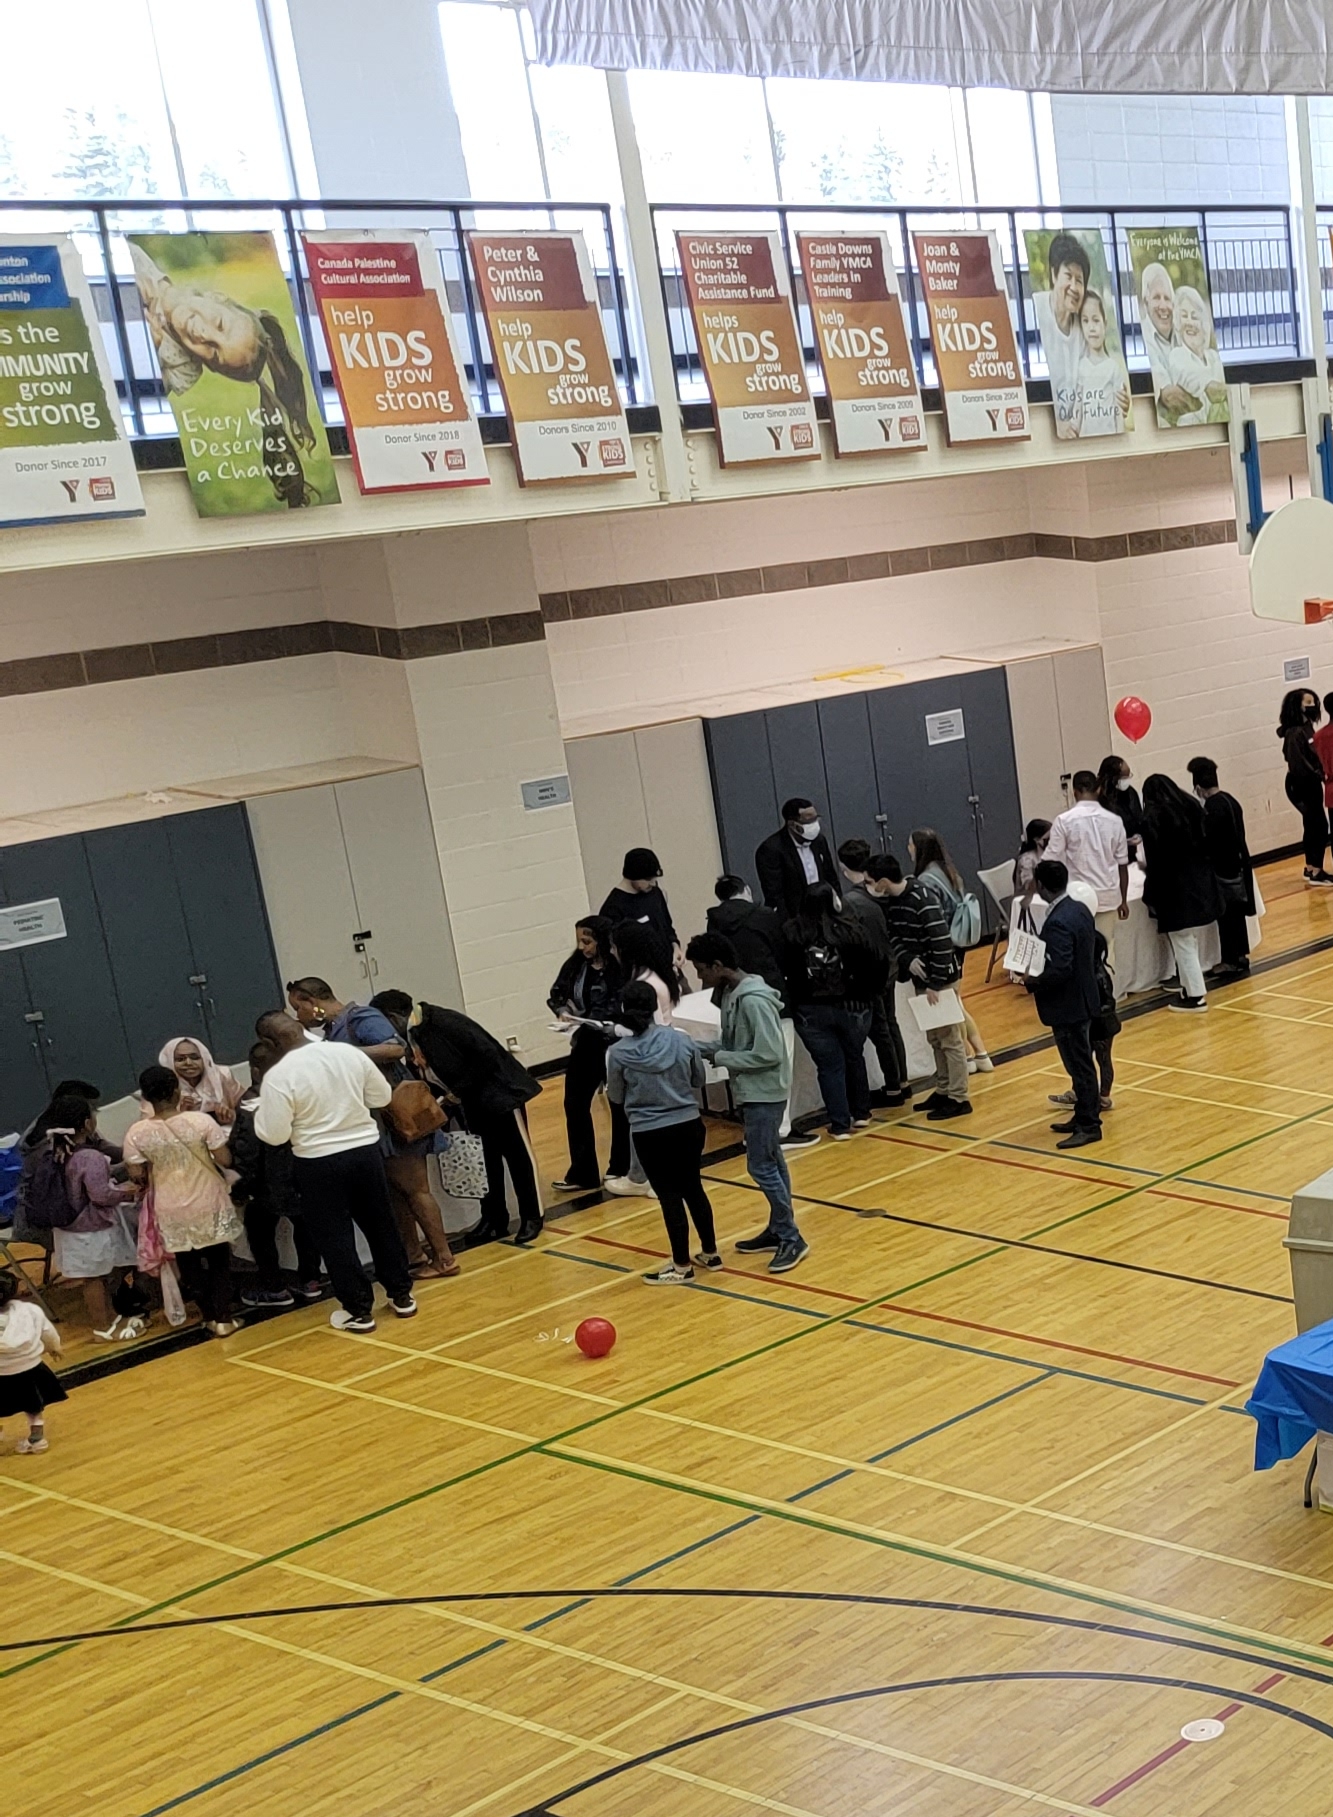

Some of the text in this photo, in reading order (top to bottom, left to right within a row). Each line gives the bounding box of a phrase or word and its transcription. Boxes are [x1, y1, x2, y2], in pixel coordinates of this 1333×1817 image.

[483, 246, 539, 262] Peter &
[689, 241, 752, 255] Civic Service
[809, 243, 871, 255] Castle Downs
[923, 243, 959, 257] Joan &
[692, 258, 739, 269] Union 52
[811, 258, 871, 271] Family YMCA
[926, 259, 960, 276] Monty
[321, 273, 410, 284] Cultural Association
[487, 266, 544, 283] Cynthia
[695, 273, 747, 285] Charitable
[812, 272, 861, 284] Leaders in
[814, 285, 852, 299] Training
[929, 278, 957, 291] Baker
[491, 287, 543, 303] Wilson
[698, 287, 775, 300] Assistance Fund
[331, 305, 373, 328] help
[703, 313, 739, 329] helps
[18, 323, 60, 343] the
[498, 320, 531, 338] help
[339, 331, 432, 369] KIDS
[707, 331, 779, 365] KIDS
[503, 339, 586, 374] KIDS
[756, 362, 781, 376] grow
[385, 367, 432, 388] grow
[559, 372, 588, 388] grow
[746, 374, 801, 394] strong
[20, 380, 72, 401] grow
[547, 384, 612, 407] strong
[1057, 388, 1105, 402] Kids are
[376, 390, 453, 413] strong
[3, 402, 100, 428] strong
[1059, 405, 1120, 421] Our Future
[182, 408, 283, 436] Every Kid
[539, 422, 616, 435] Donors Since 2010
[190, 435, 286, 457] Deserves
[385, 434, 412, 444] Donor
[414, 432, 436, 442] Since
[15, 456, 107, 472] Donor Since 2017
[197, 462, 299, 483] a Chance
